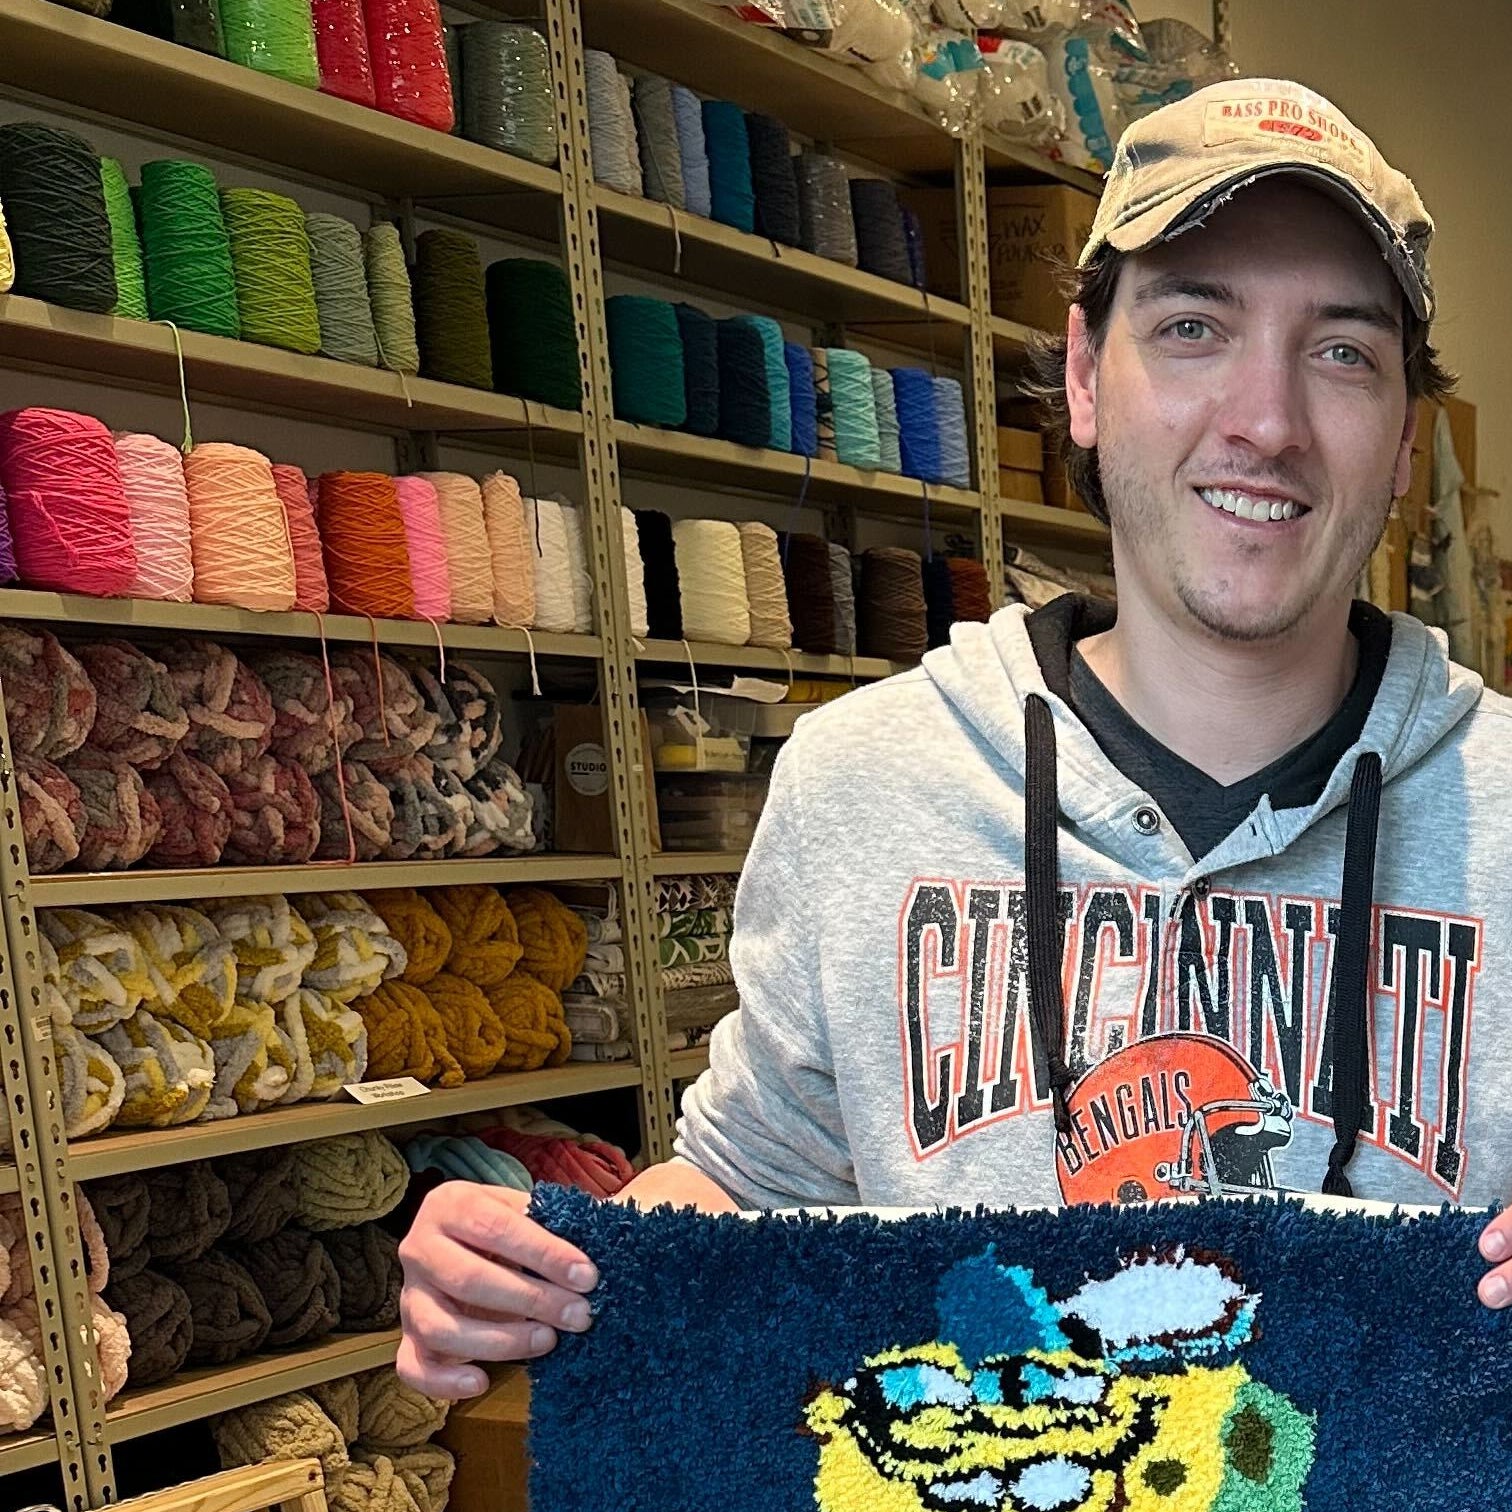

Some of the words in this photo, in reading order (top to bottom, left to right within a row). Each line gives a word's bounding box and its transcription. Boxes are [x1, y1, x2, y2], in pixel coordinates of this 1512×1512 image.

[1221, 101, 1263, 119] BASS
[1267, 100, 1303, 121] PRO
[570, 761, 607, 772] STUDIO
[1055, 1070, 1194, 1177] BENGALS
